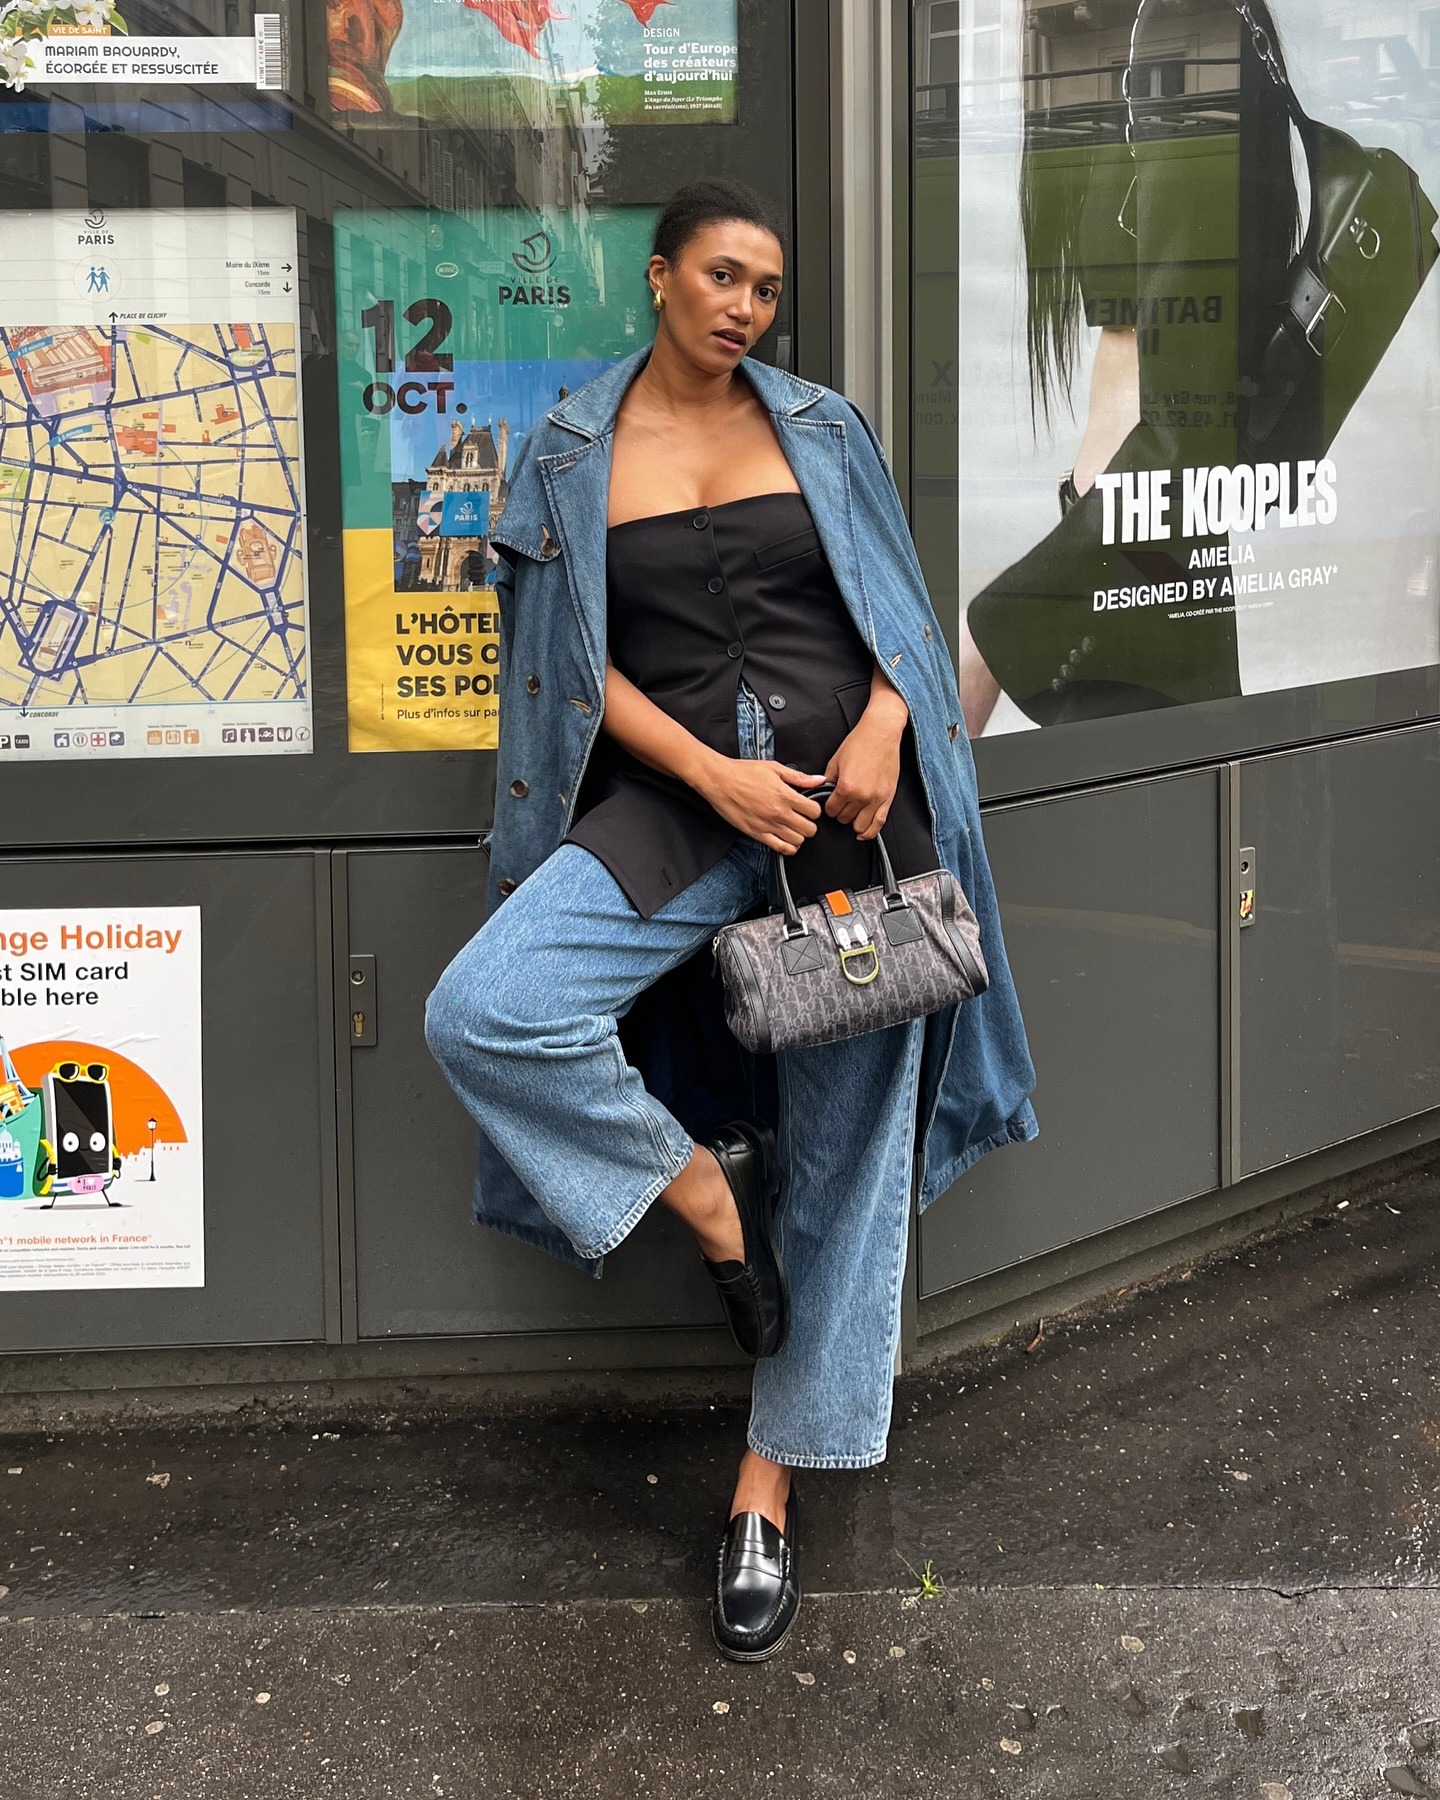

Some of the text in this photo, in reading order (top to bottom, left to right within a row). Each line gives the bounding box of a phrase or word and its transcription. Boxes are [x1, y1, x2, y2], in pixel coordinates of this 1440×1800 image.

[644, 28, 680, 38] DESIGN
[45, 46, 180, 58] MARIAM BAOUARDY,
[644, 43, 738, 56] Tour d'Europe
[46, 61, 219, 75] ÉGORGÉE ET RESSUSCITÉE
[644, 56, 736, 68] des créateurs
[644, 70, 732, 84] d'aujourd'hui
[78, 235, 114, 244] PARIS
[498, 286, 571, 305] PARIS
[362, 298, 454, 372] 12
[363, 382, 468, 415] OCT.
[1095, 458, 1338, 546] THE KOOPLES
[1188, 544, 1256, 570] AMELIA
[1093, 582, 1188, 612] DESIGNED
[1192, 578, 1218, 600] BY
[1220, 571, 1285, 597] AMELIA
[396, 644, 473, 666] VOUS
[397, 676, 446, 698] SES
[398, 708, 499, 719] Plus d'infos sur pa
[61, 924, 182, 954] Holiday
[0, 962, 128, 981] t SIM card
[46, 988, 99, 1006] here
[16, 1236, 52, 1244] mobile
[55, 1235, 97, 1244] network
[100, 1234, 109, 1243] in
